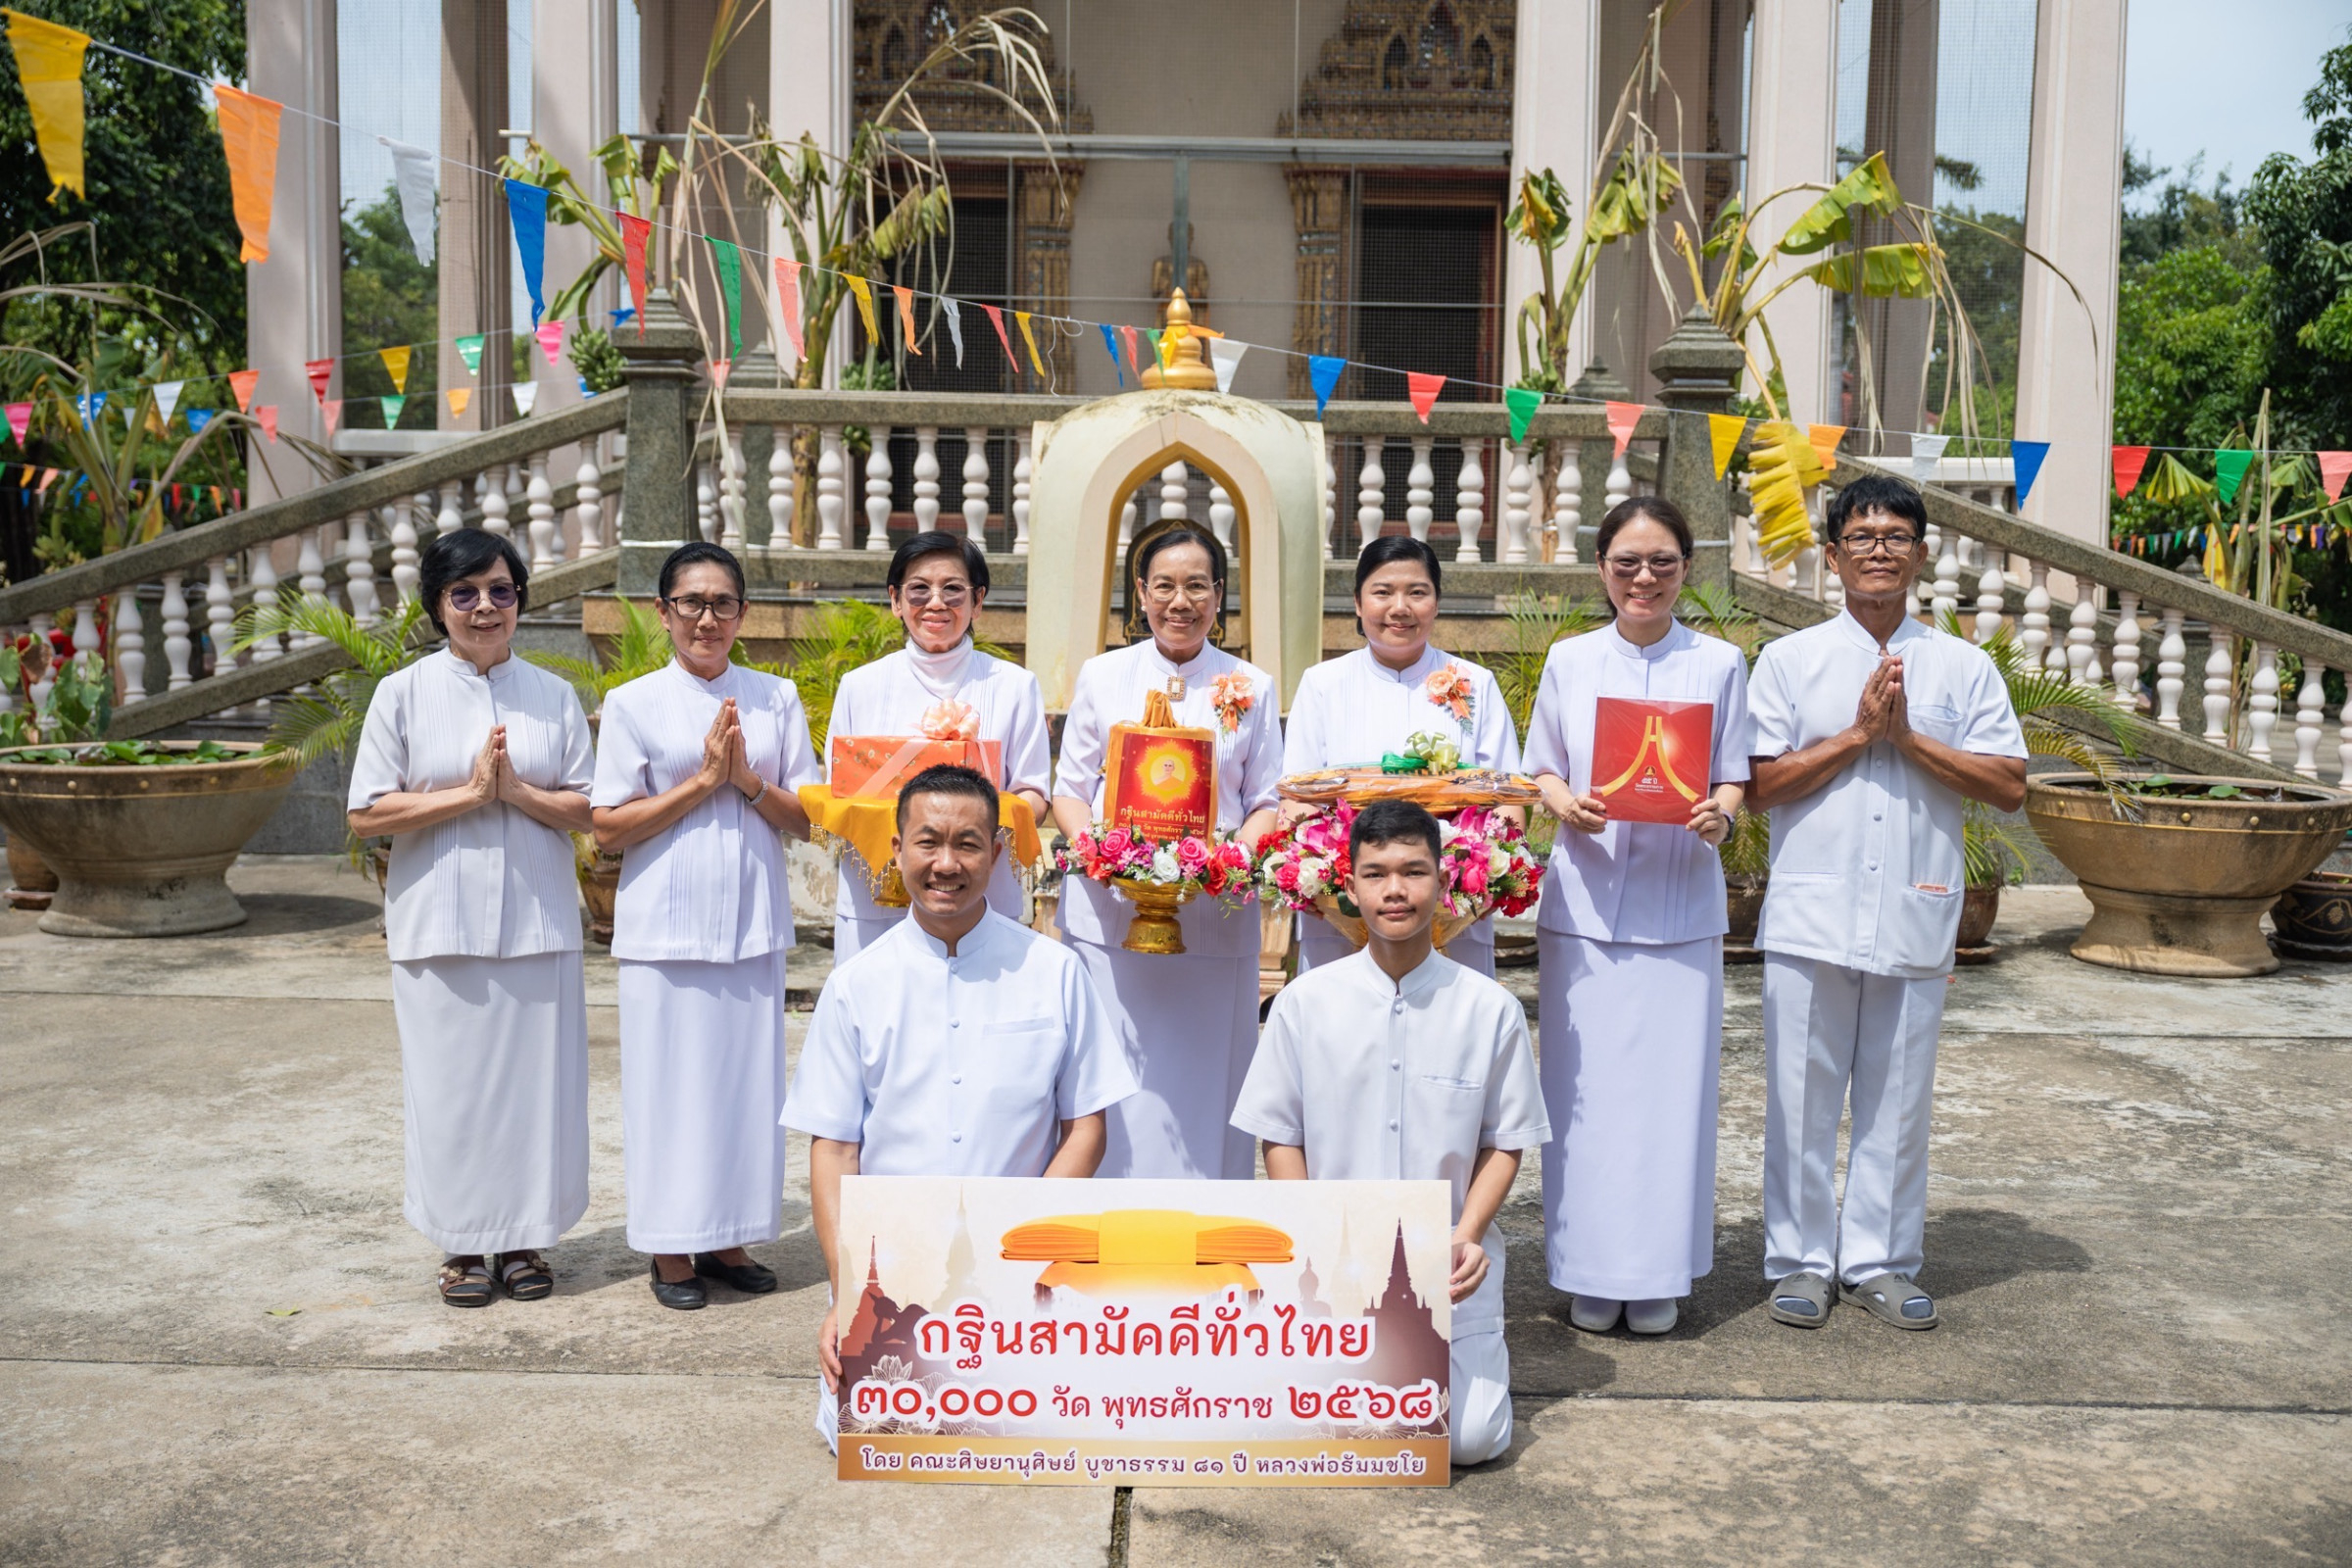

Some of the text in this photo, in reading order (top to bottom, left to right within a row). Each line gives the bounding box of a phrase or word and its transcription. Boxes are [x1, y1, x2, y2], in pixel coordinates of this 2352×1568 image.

[920, 1290, 1369, 1370] กฐินสามัคคีทั่วไทย
[858, 1385, 1433, 1430] ๓๐,๐๐๐ วัด พุทธศักราช ๒๕๖๘
[861, 1447, 1425, 1479] โดย คณะศิษยานุศิษย์ บูชาธรรม ๘๑ ปี หลวงพ่อธัมมชโย
